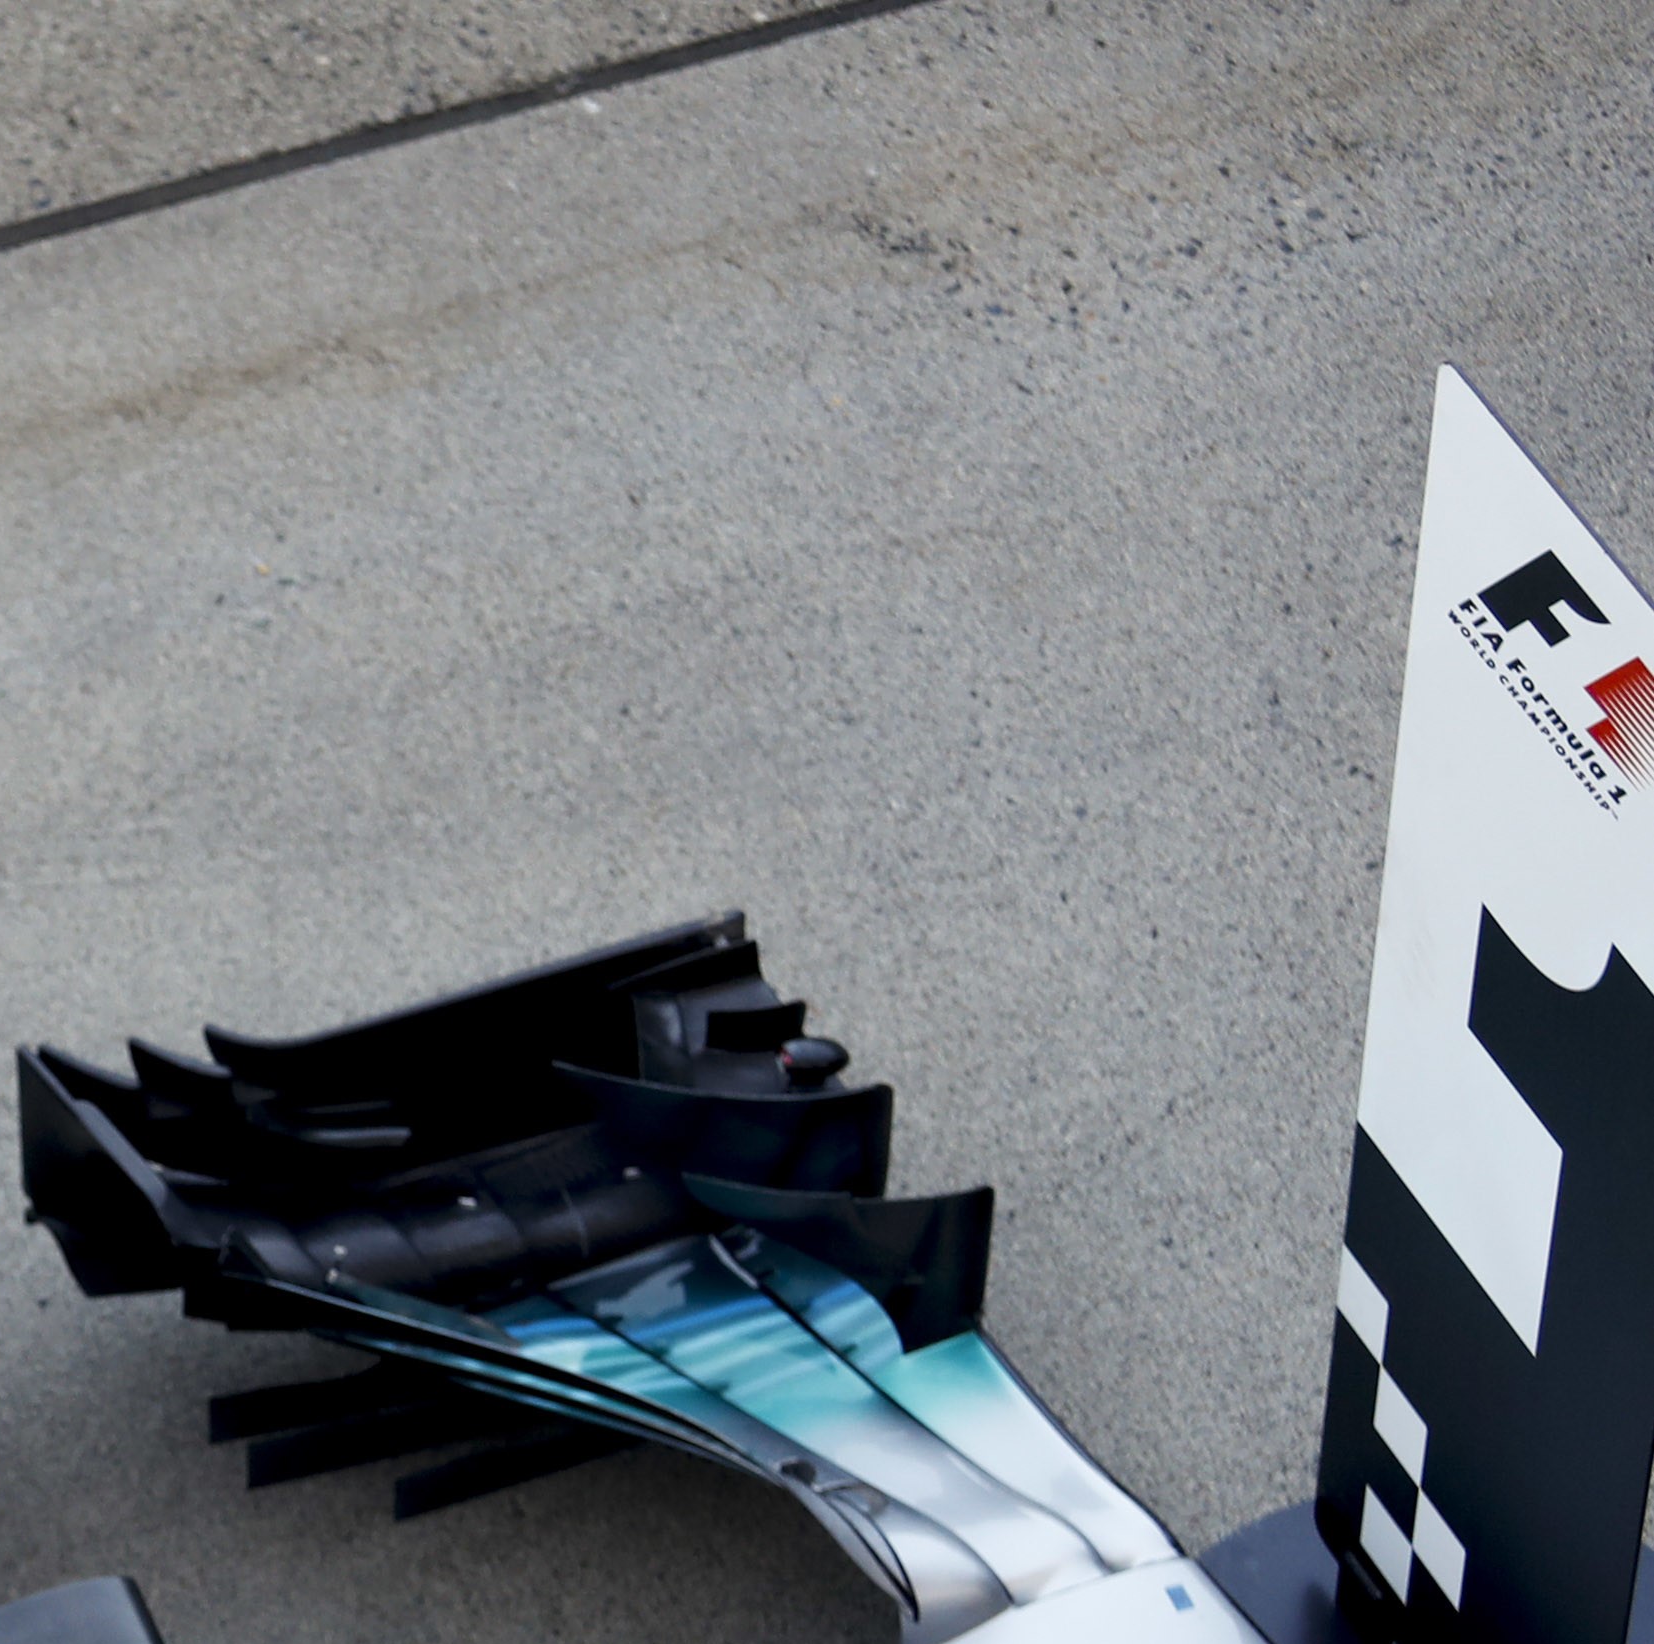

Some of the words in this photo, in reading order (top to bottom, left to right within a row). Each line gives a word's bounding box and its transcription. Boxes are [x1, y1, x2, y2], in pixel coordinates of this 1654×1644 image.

[1448, 610, 1496, 669] WORLD
[1458, 598, 1504, 653] FIA
[1505, 657, 1607, 780] Formula
[1607, 785, 1628, 805] 1
